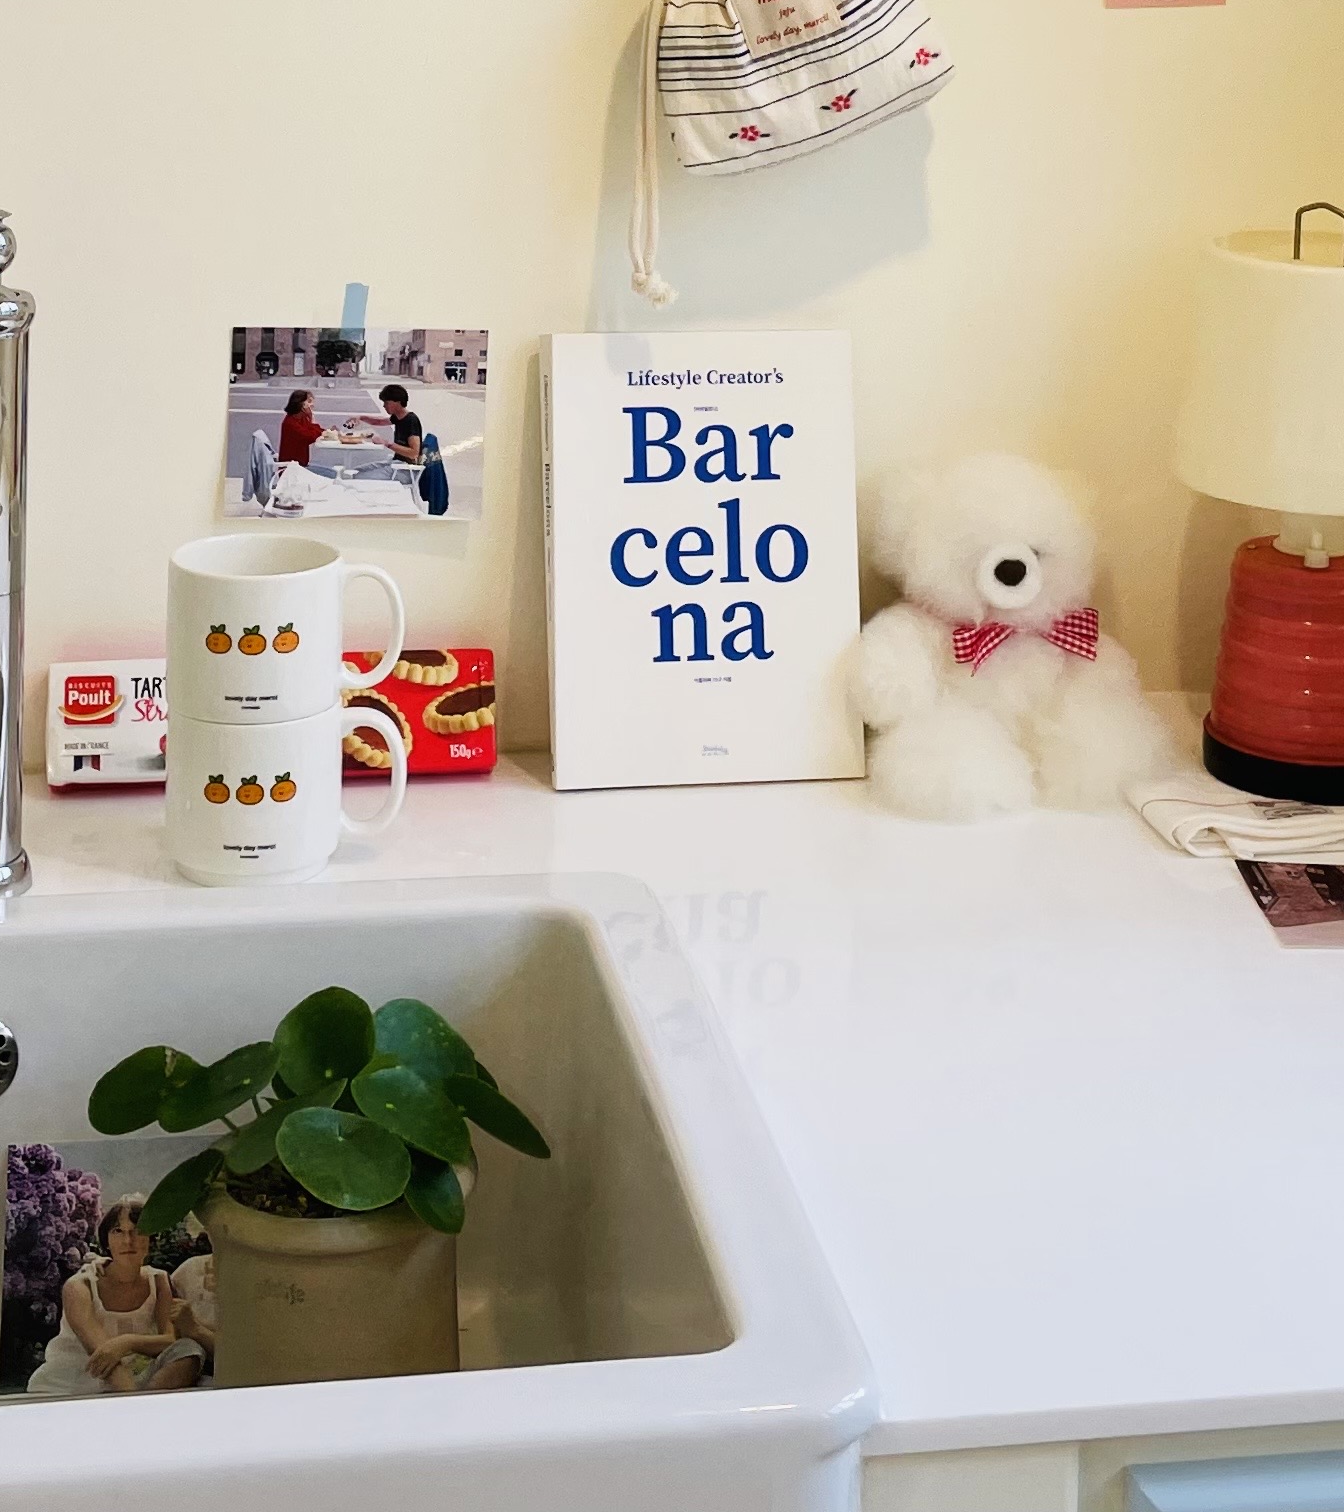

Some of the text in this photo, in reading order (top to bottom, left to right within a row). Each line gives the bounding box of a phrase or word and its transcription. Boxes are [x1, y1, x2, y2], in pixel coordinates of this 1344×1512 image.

[627, 367, 784, 390] Lifestyle Creator's
[622, 405, 794, 485] Bar
[609, 498, 809, 589] celo
[651, 600, 775, 665] na
[68, 690, 112, 706] Poult
[131, 677, 167, 699] TAR
[131, 698, 168, 722] Str
